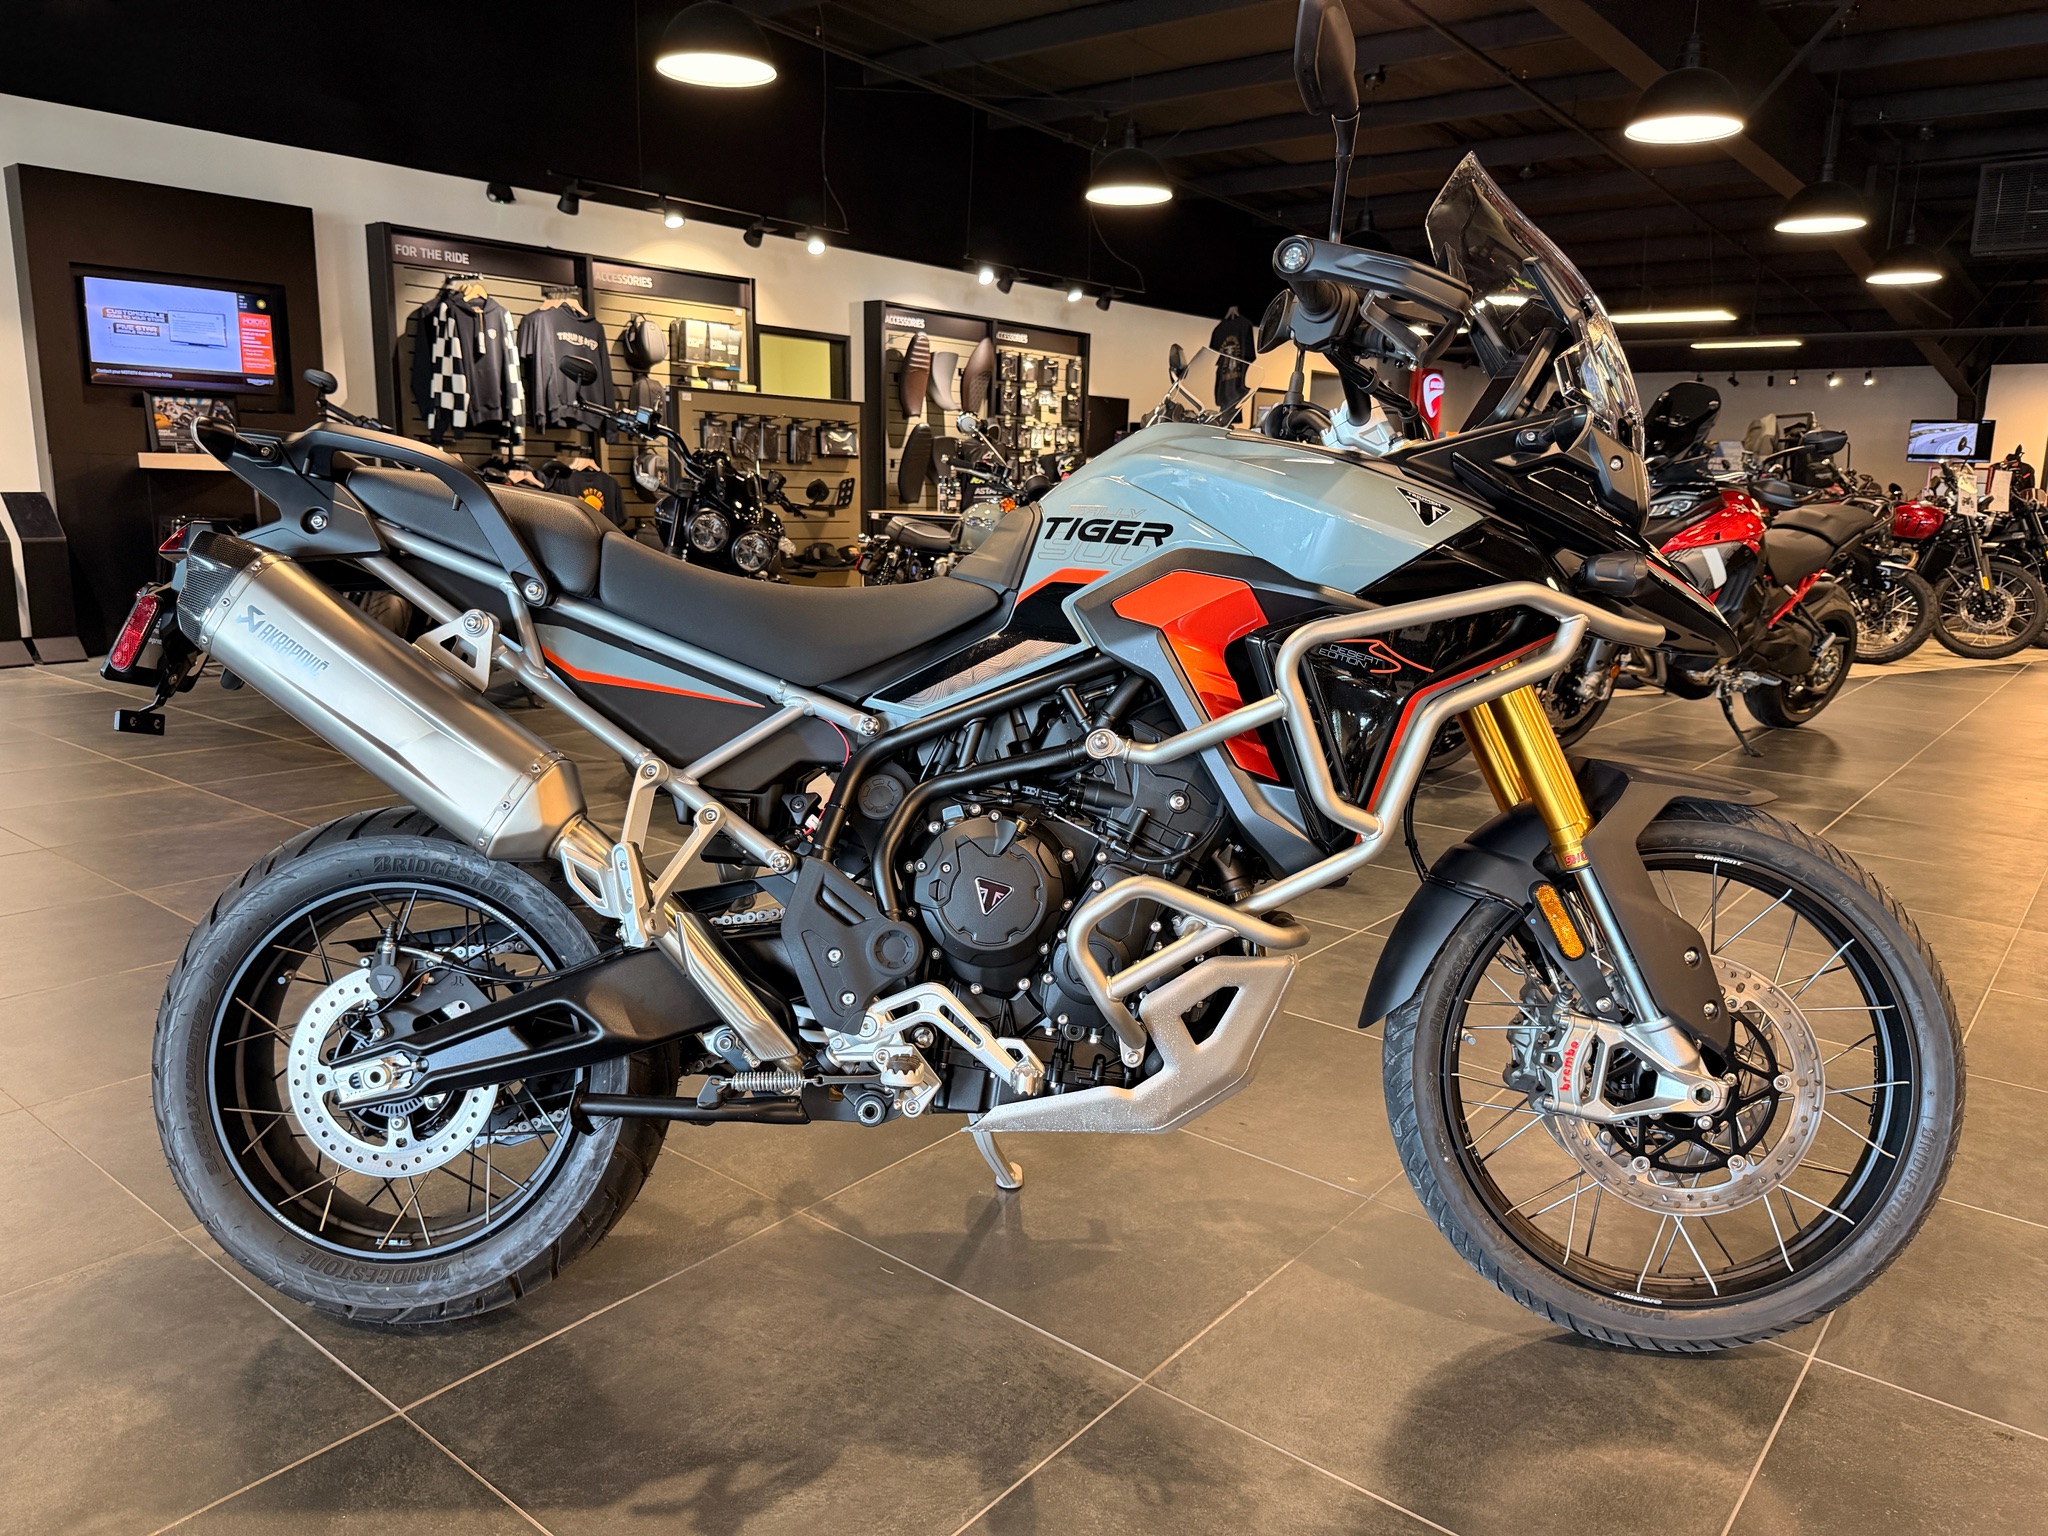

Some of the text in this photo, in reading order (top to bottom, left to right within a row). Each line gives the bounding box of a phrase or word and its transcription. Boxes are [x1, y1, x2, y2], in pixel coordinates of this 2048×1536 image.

[395, 244, 470, 264] FOR THE RIDE
[595, 272, 652, 288] ACCESSORIES
[884, 315, 925, 329] ACCESSORIES
[1067, 506, 1147, 518] RALLY
[1044, 517, 1174, 548] TIGER
[1318, 648, 1368, 668] EDITION
[1330, 644, 1383, 666] DESERT
[374, 856, 524, 906] BRIDGESTONE
[1560, 1041, 1579, 1092] brembo
[1871, 1125, 1937, 1239] BRIDGESTONE
[297, 1251, 450, 1284] BRIDGESTONE
